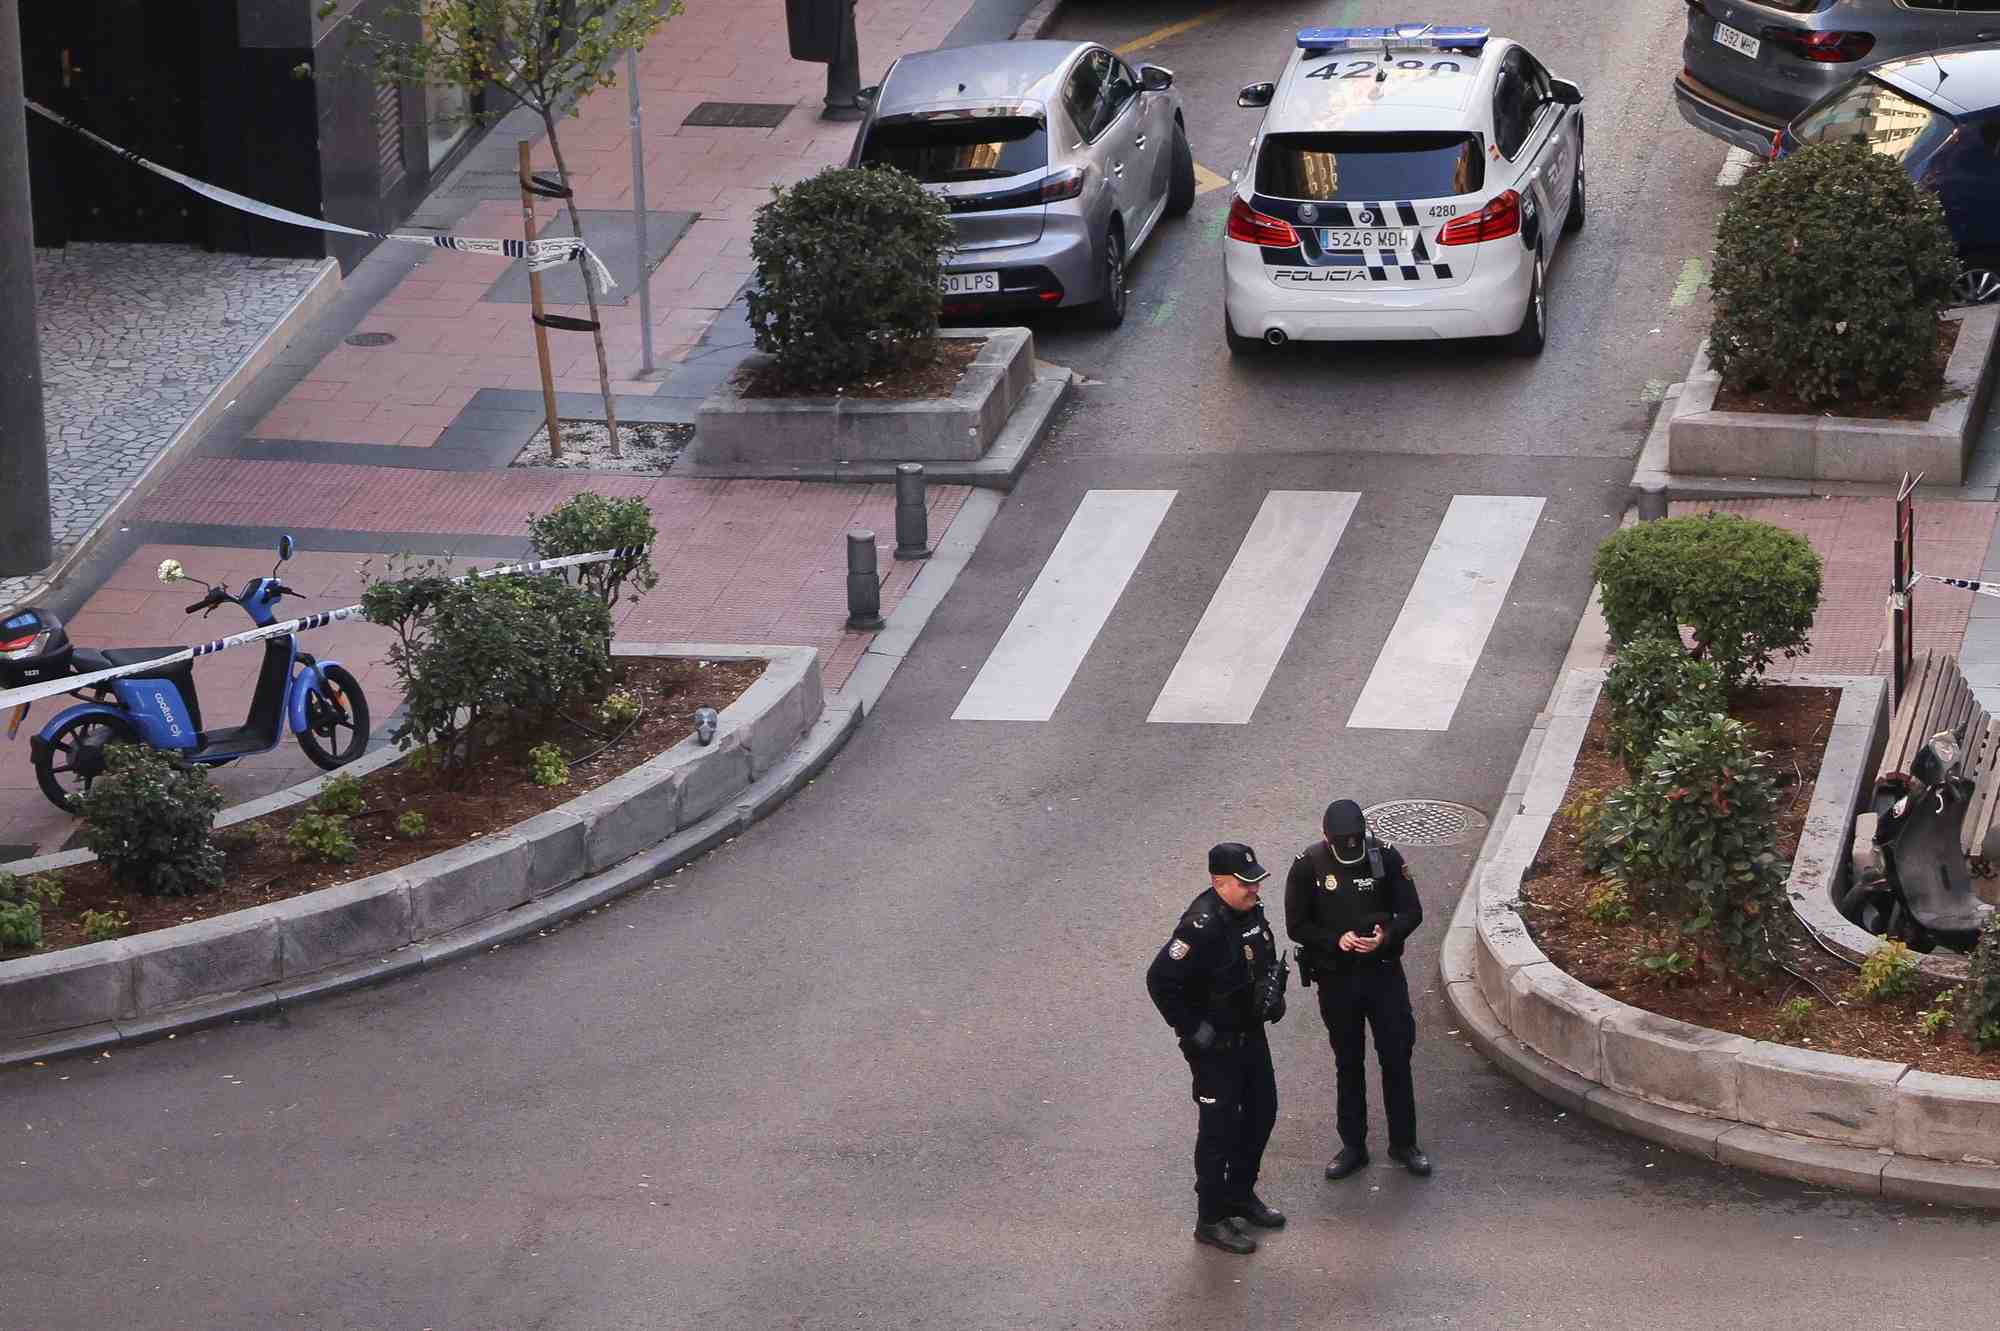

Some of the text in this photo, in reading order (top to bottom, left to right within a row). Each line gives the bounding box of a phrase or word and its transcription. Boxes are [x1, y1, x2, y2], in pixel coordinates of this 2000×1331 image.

[1428, 204, 1457, 217] 4280
[1331, 231, 1408, 247] 5246 MDH
[964, 274, 994, 290] LPS
